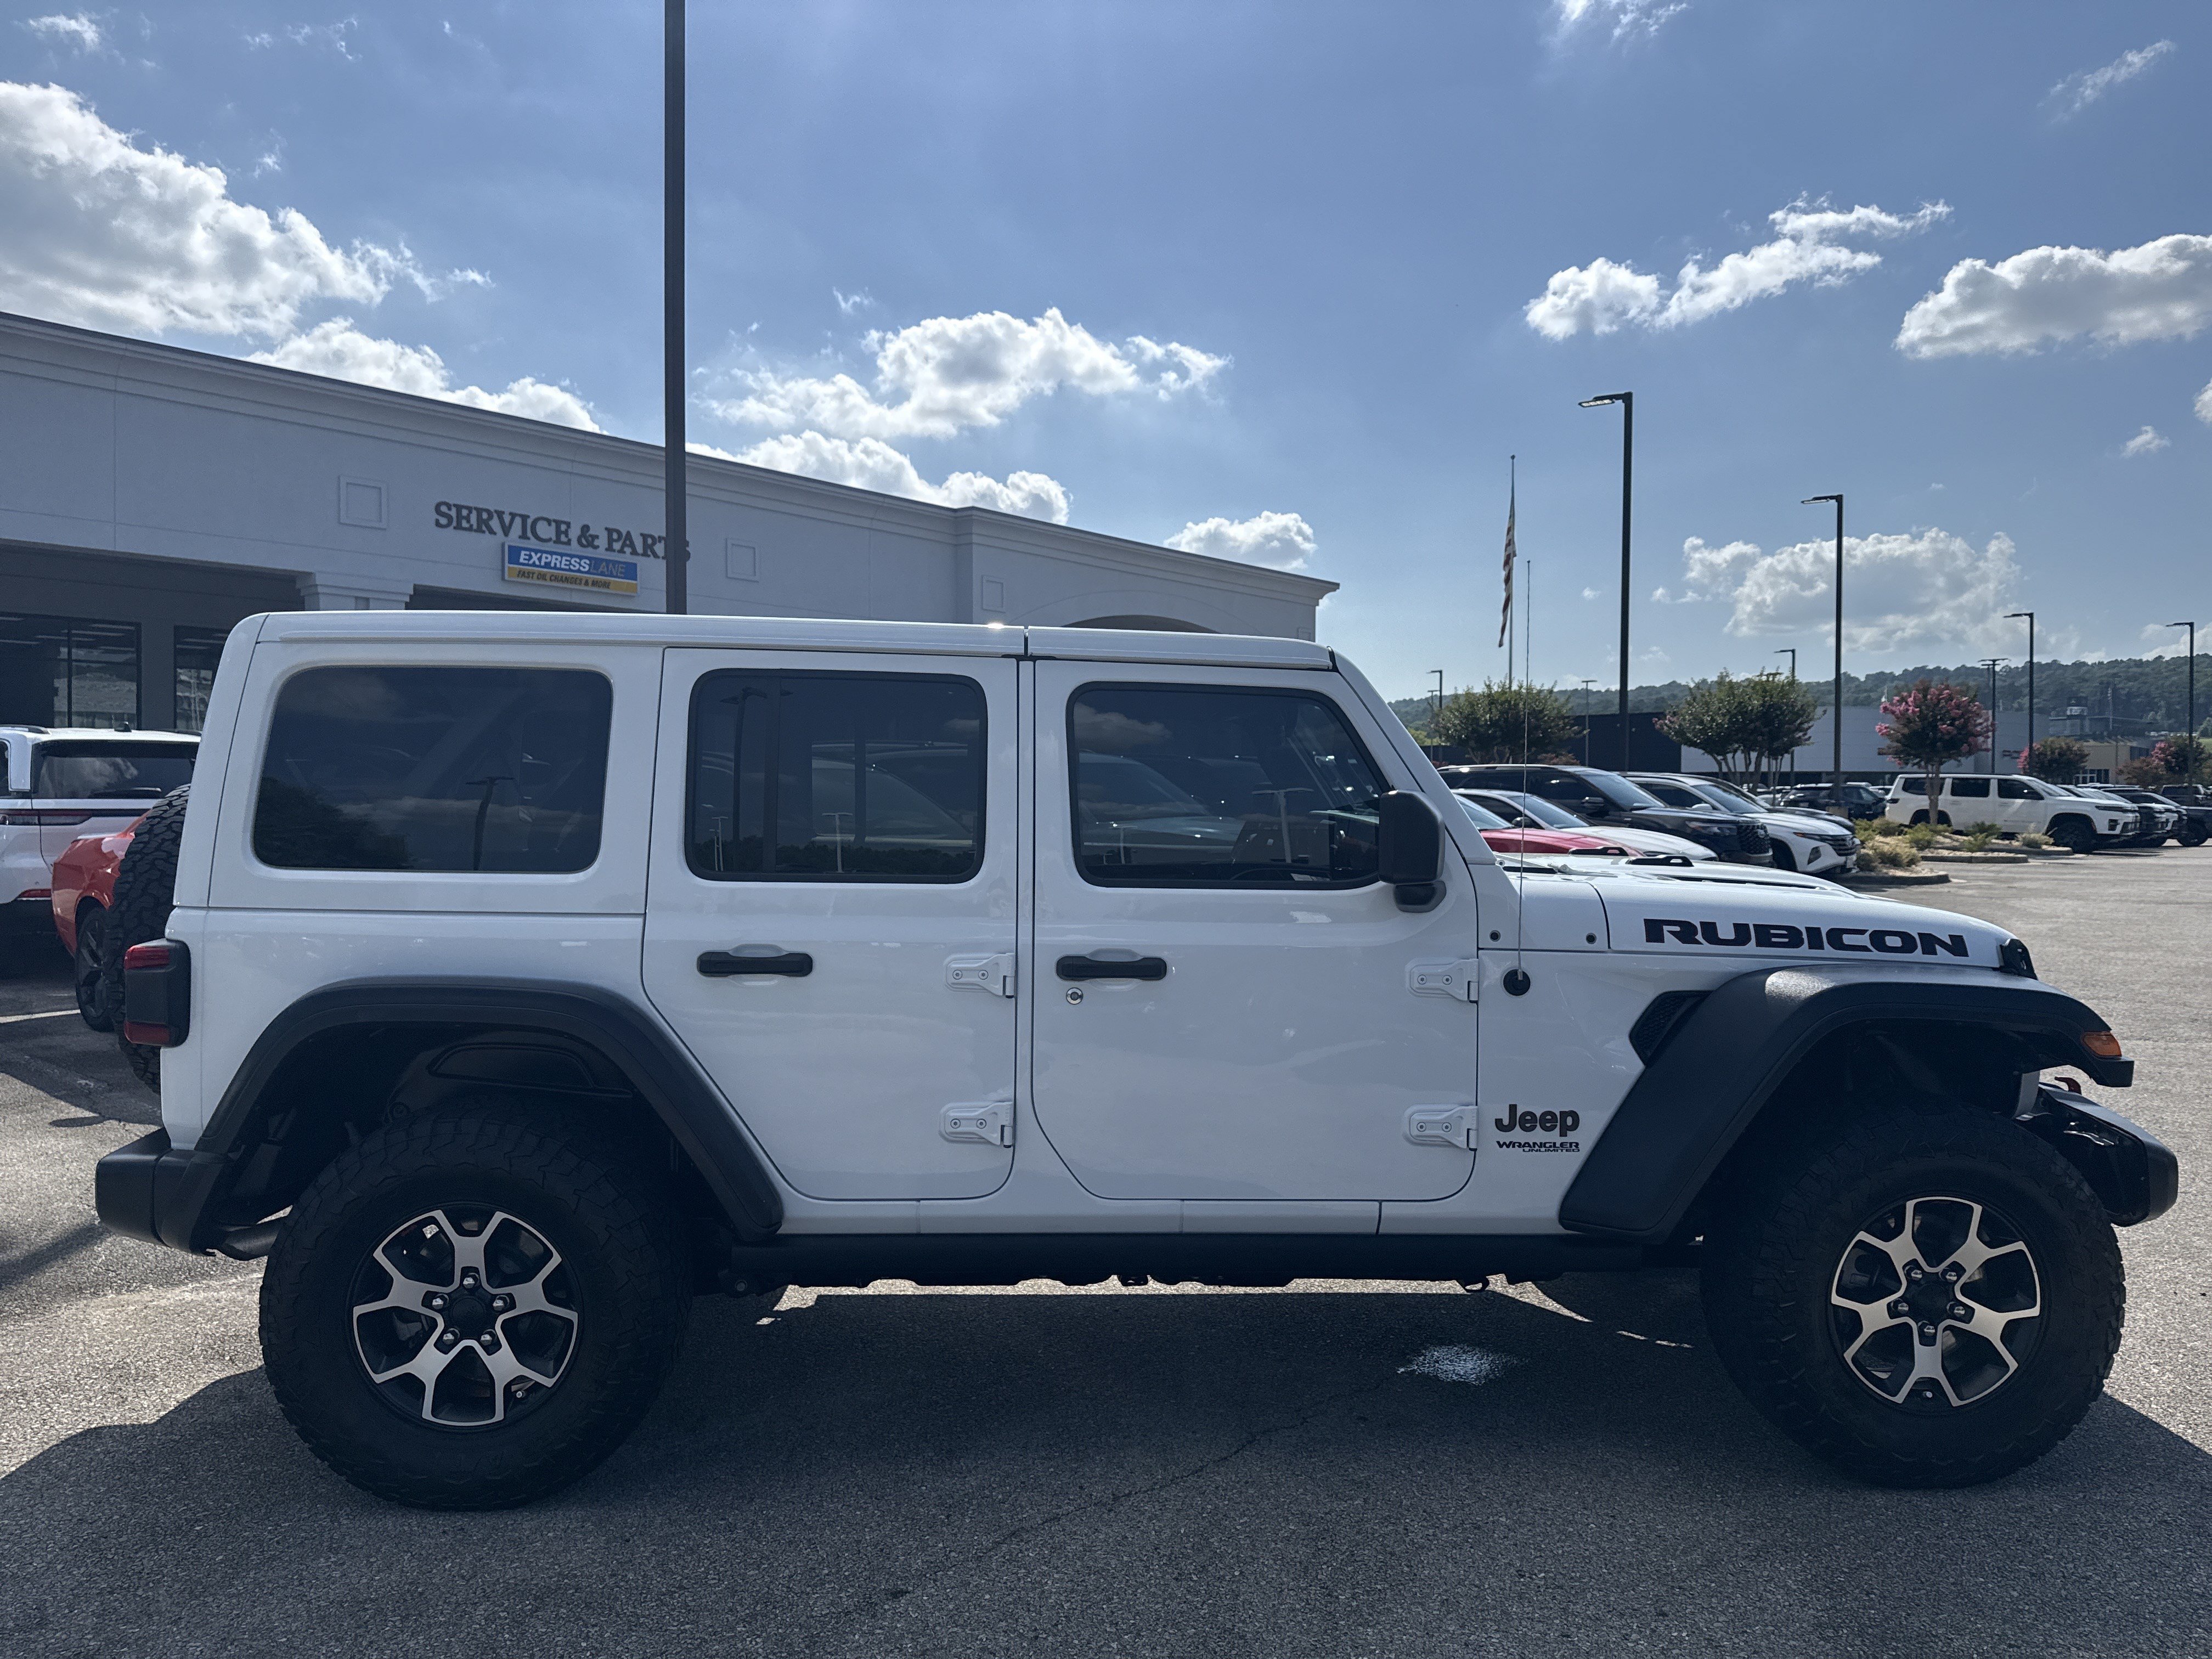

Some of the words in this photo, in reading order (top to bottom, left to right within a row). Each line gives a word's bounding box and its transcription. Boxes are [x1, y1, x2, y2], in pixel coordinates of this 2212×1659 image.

[435, 501, 572, 546] SERVICE
[577, 524, 600, 549] &
[517, 570, 535, 579] FAST
[537, 572, 548, 582] OIL
[549, 574, 583, 586] CHANGES
[591, 579, 611, 590] MORE
[520, 550, 590, 572] EXPRESS
[590, 560, 627, 577] LANE
[1644, 918, 1969, 957] RUBICON
[1495, 1104, 1579, 1137] Jeep
